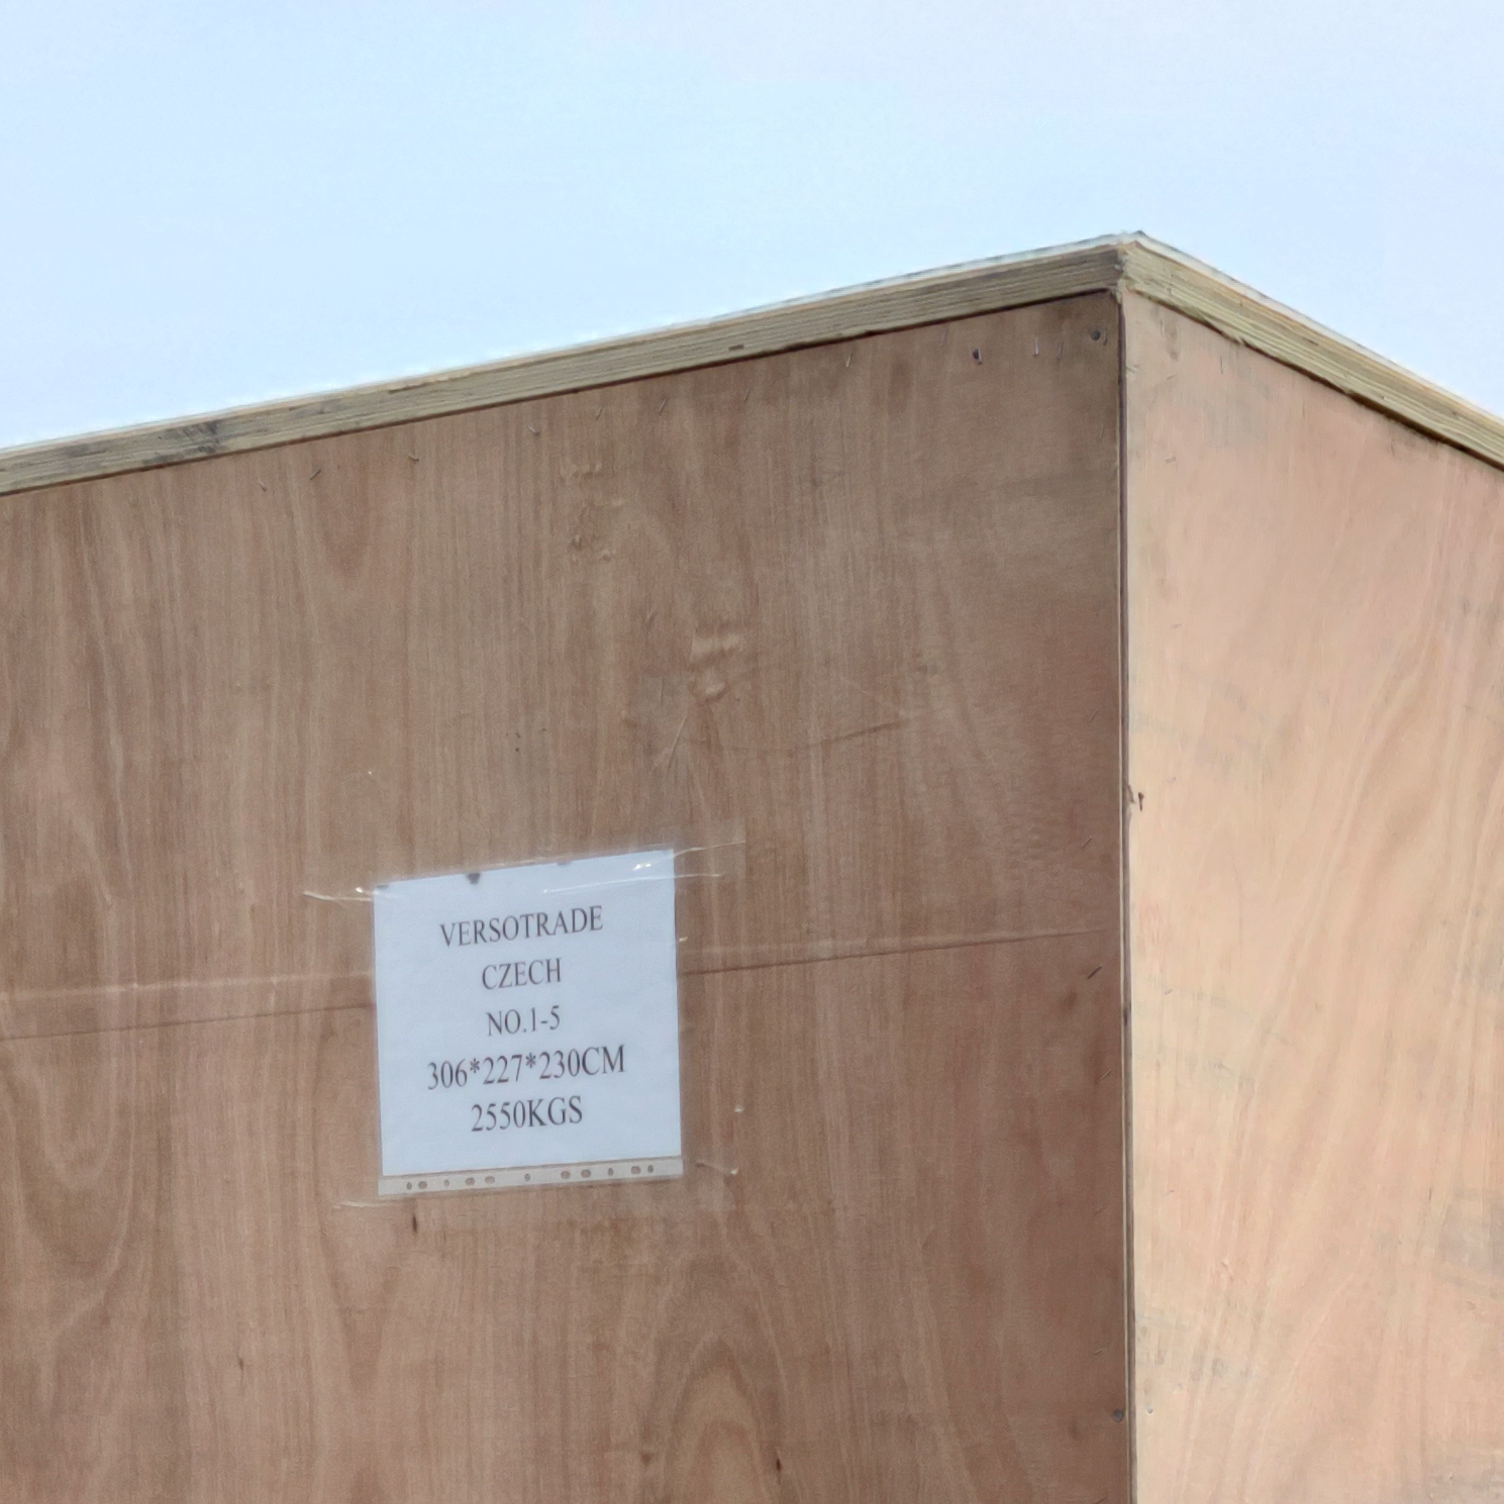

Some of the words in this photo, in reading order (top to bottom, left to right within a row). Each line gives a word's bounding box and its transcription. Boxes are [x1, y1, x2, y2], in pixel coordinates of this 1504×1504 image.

[439, 905, 604, 947] VERSOTRADE
[481, 957, 562, 990] CZECH
[486, 1005, 561, 1036] NO.1-5
[471, 1096, 583, 1132] 2550KGS
